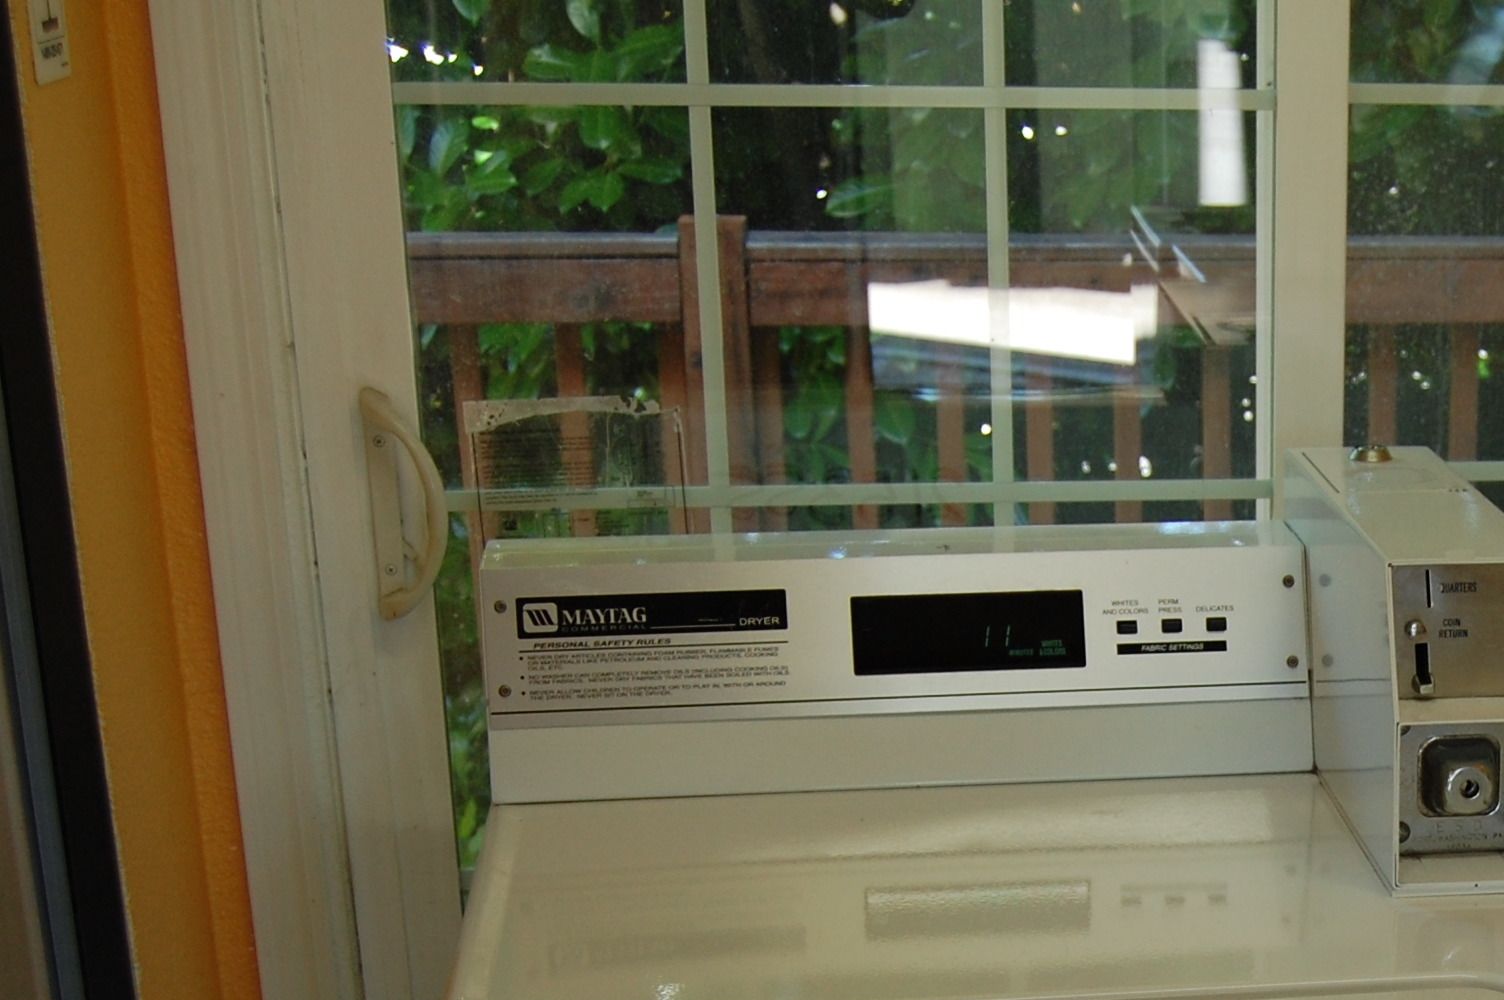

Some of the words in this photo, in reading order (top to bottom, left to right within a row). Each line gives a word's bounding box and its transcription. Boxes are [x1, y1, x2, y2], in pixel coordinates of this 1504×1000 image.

[1158, 606, 1183, 614] PRESS
[1195, 604, 1235, 612] DELICATES
[561, 606, 647, 626] MAYTAG
[739, 617, 781, 626] DRYER
